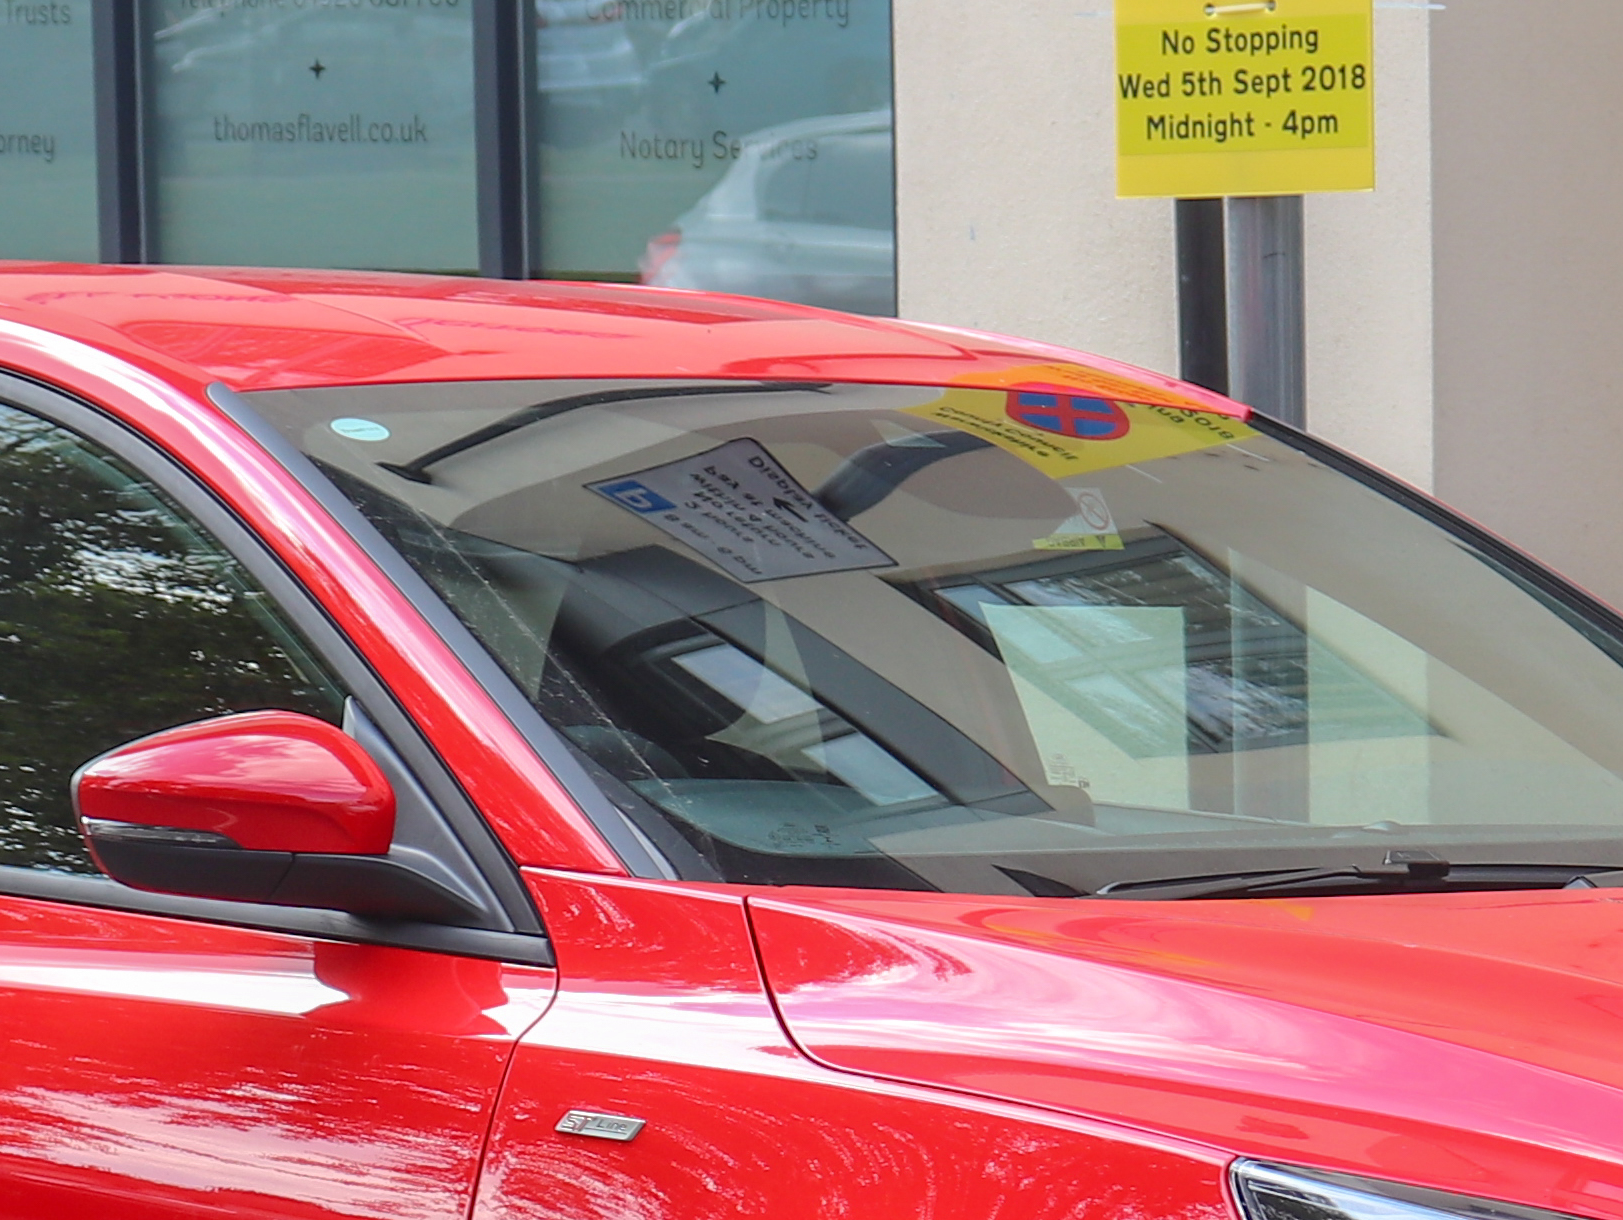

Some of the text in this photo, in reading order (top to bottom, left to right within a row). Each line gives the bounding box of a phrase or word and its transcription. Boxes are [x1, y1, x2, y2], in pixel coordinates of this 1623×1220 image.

[586, 0, 731, 20] Commeral
[1161, 24, 1320, 57] No Stopping
[1118, 63, 1367, 99] Wed 5th Sept 2018
[213, 113, 429, 143] thomasflavell.co.uk
[1146, 111, 1256, 143] Midnight
[1281, 109, 1339, 139] 4pm
[619, 130, 819, 169] Notary Seices
[596, 1118, 628, 1132] Line
